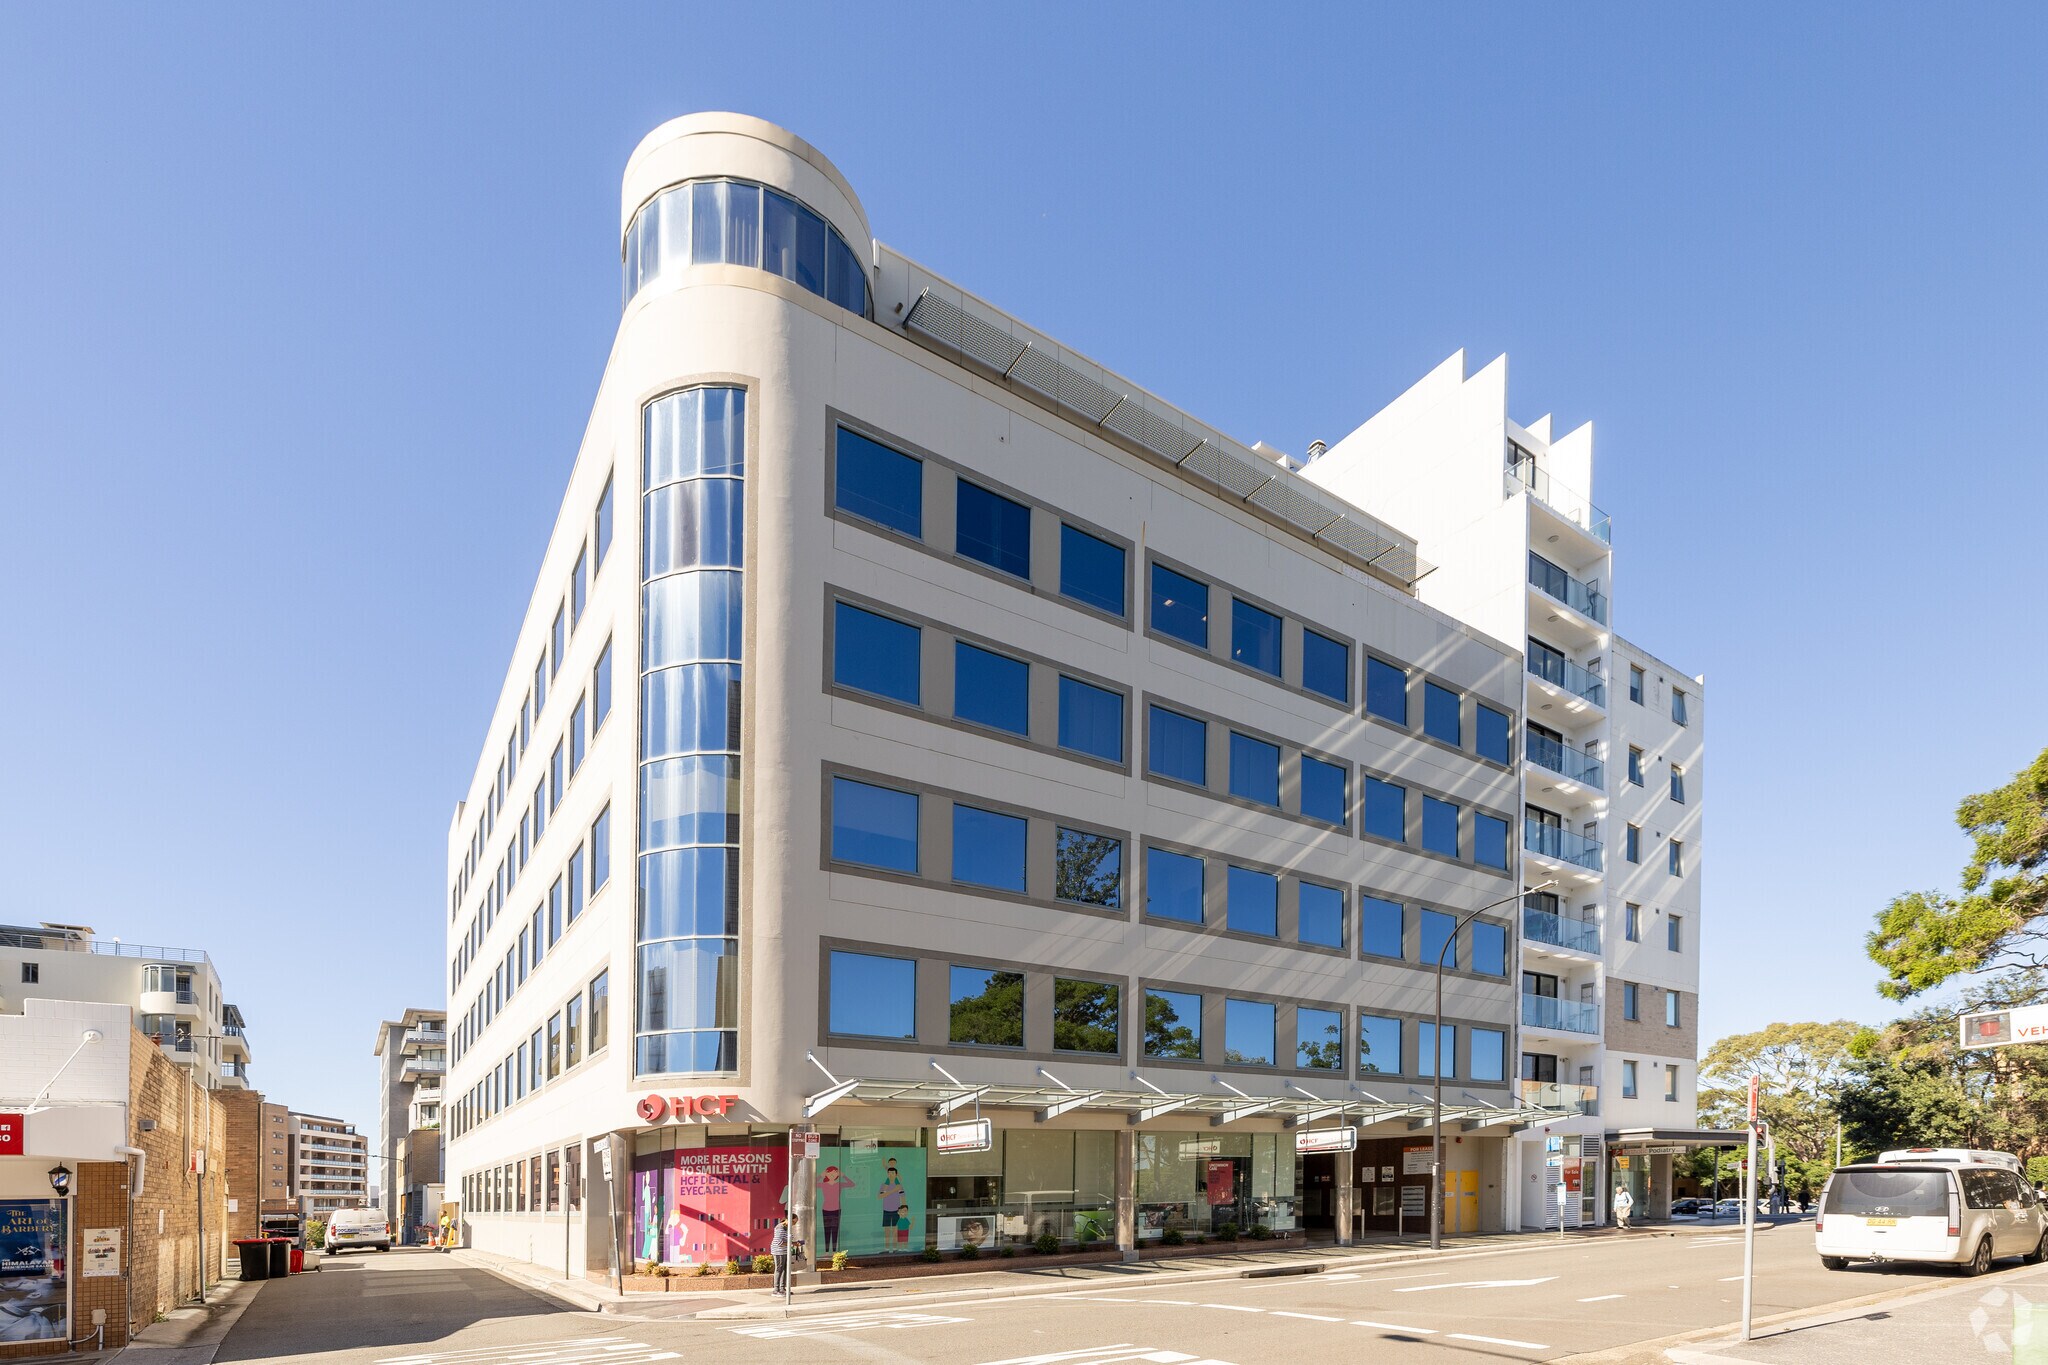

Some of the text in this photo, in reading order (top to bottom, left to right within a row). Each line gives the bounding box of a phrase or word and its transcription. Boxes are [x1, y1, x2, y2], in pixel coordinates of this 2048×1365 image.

[669, 1095, 738, 1116] HCF
[681, 1154, 772, 1165] MORE REASONS
[681, 1163, 768, 1175] TO SMILE WITH
[681, 1174, 760, 1185] HCF DENTAL &
[681, 1186, 728, 1195] EYECARE
